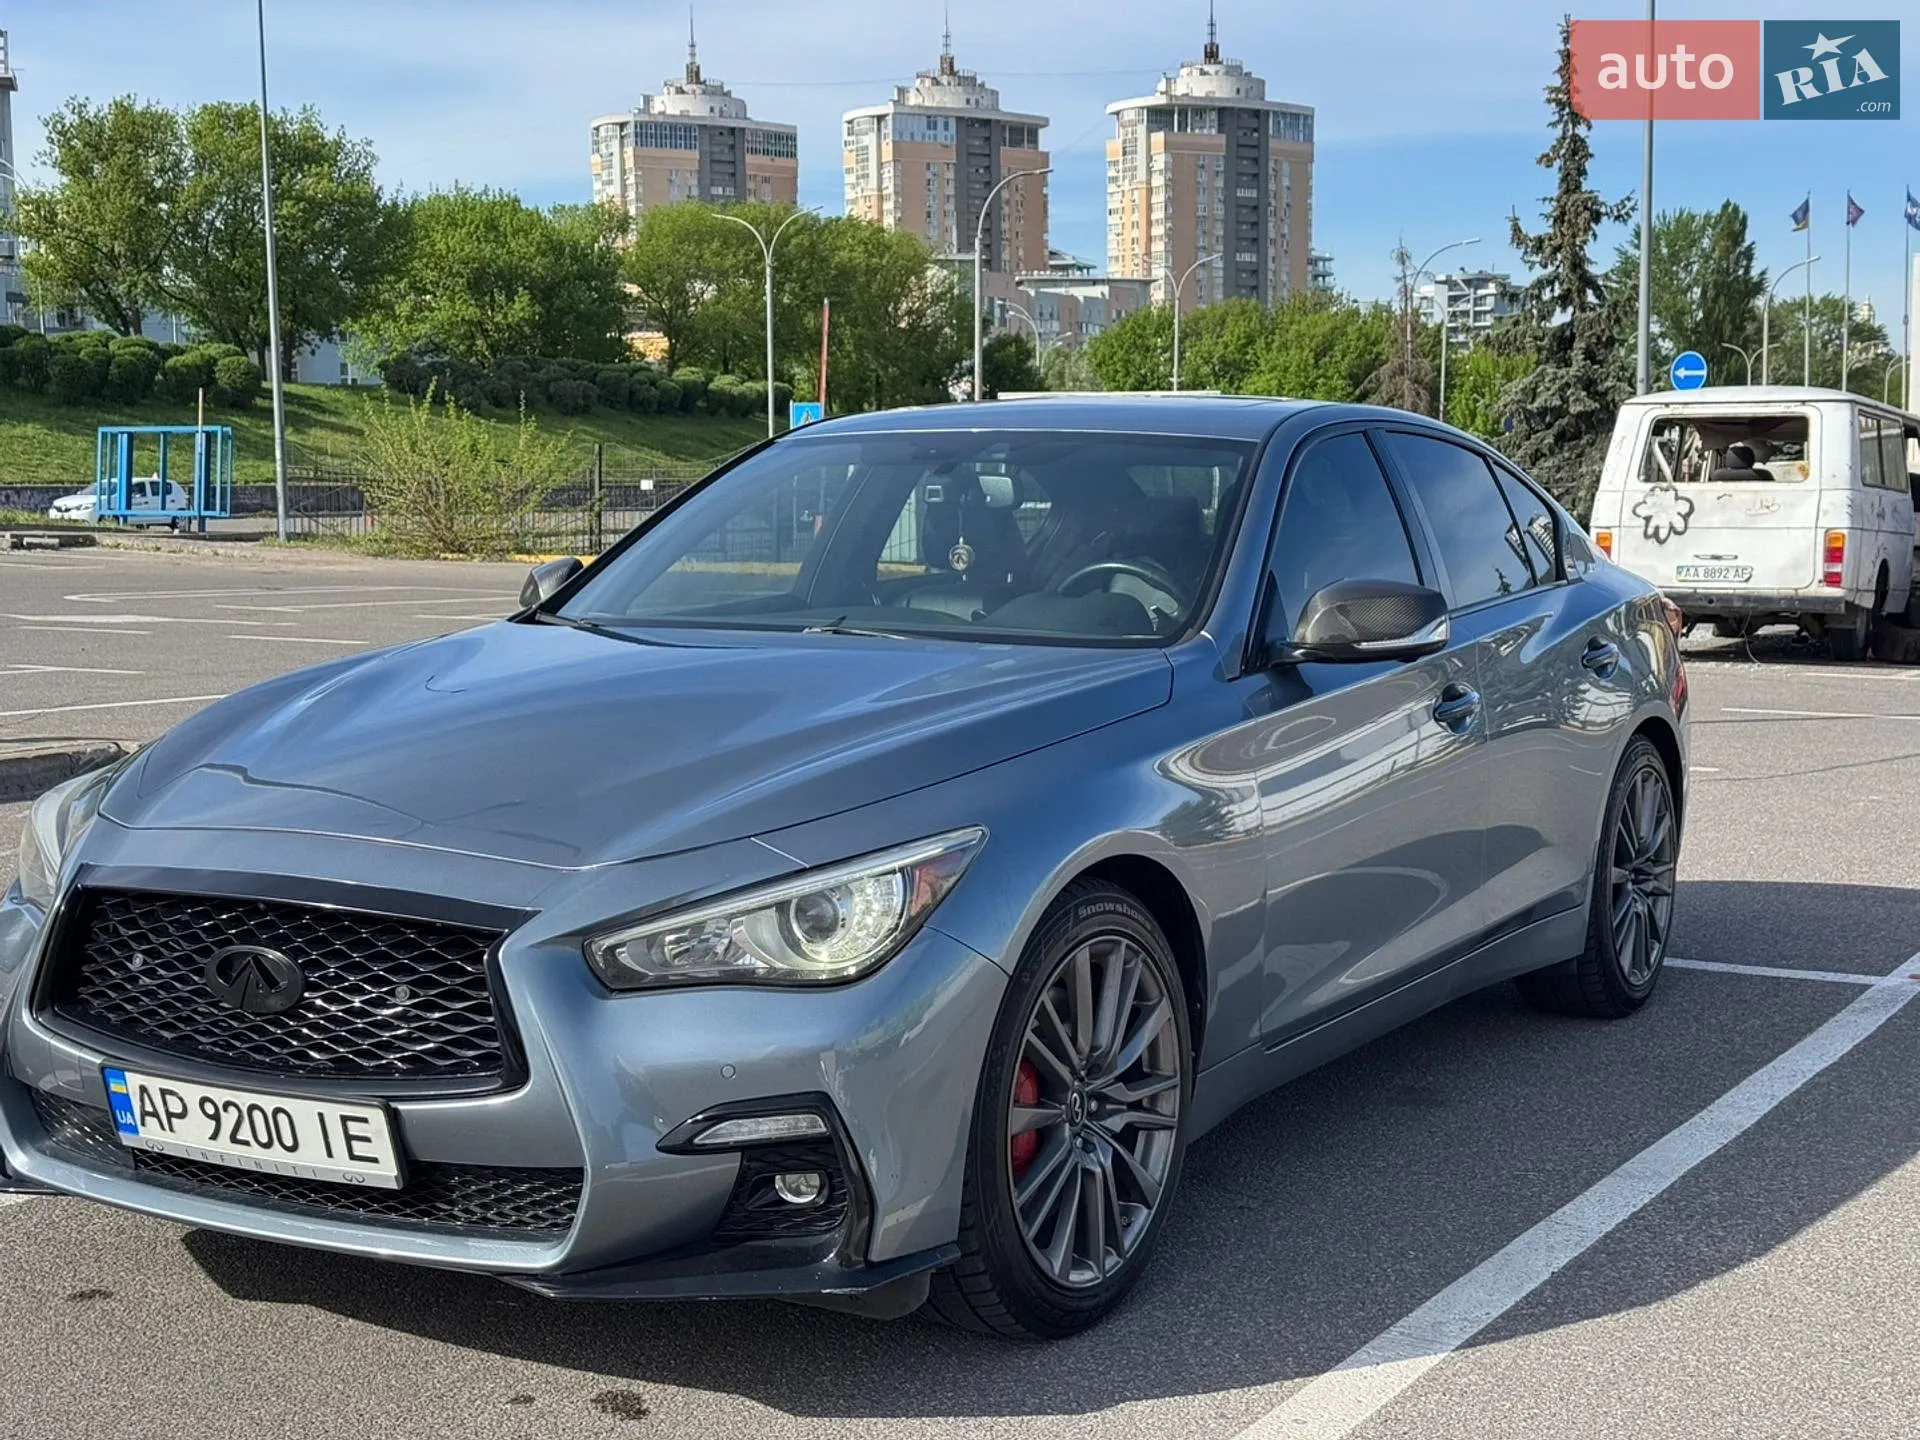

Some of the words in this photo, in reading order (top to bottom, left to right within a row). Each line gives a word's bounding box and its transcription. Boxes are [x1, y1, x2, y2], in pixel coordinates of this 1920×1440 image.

[1684, 567, 1700, 578] AA
[1703, 567, 1730, 579] 8892
[116, 1108, 136, 1126] UA
[138, 1083, 189, 1133] AP
[198, 1095, 300, 1153] 9200
[317, 1110, 380, 1164] IE
[184, 1146, 320, 1178] INFINITI
